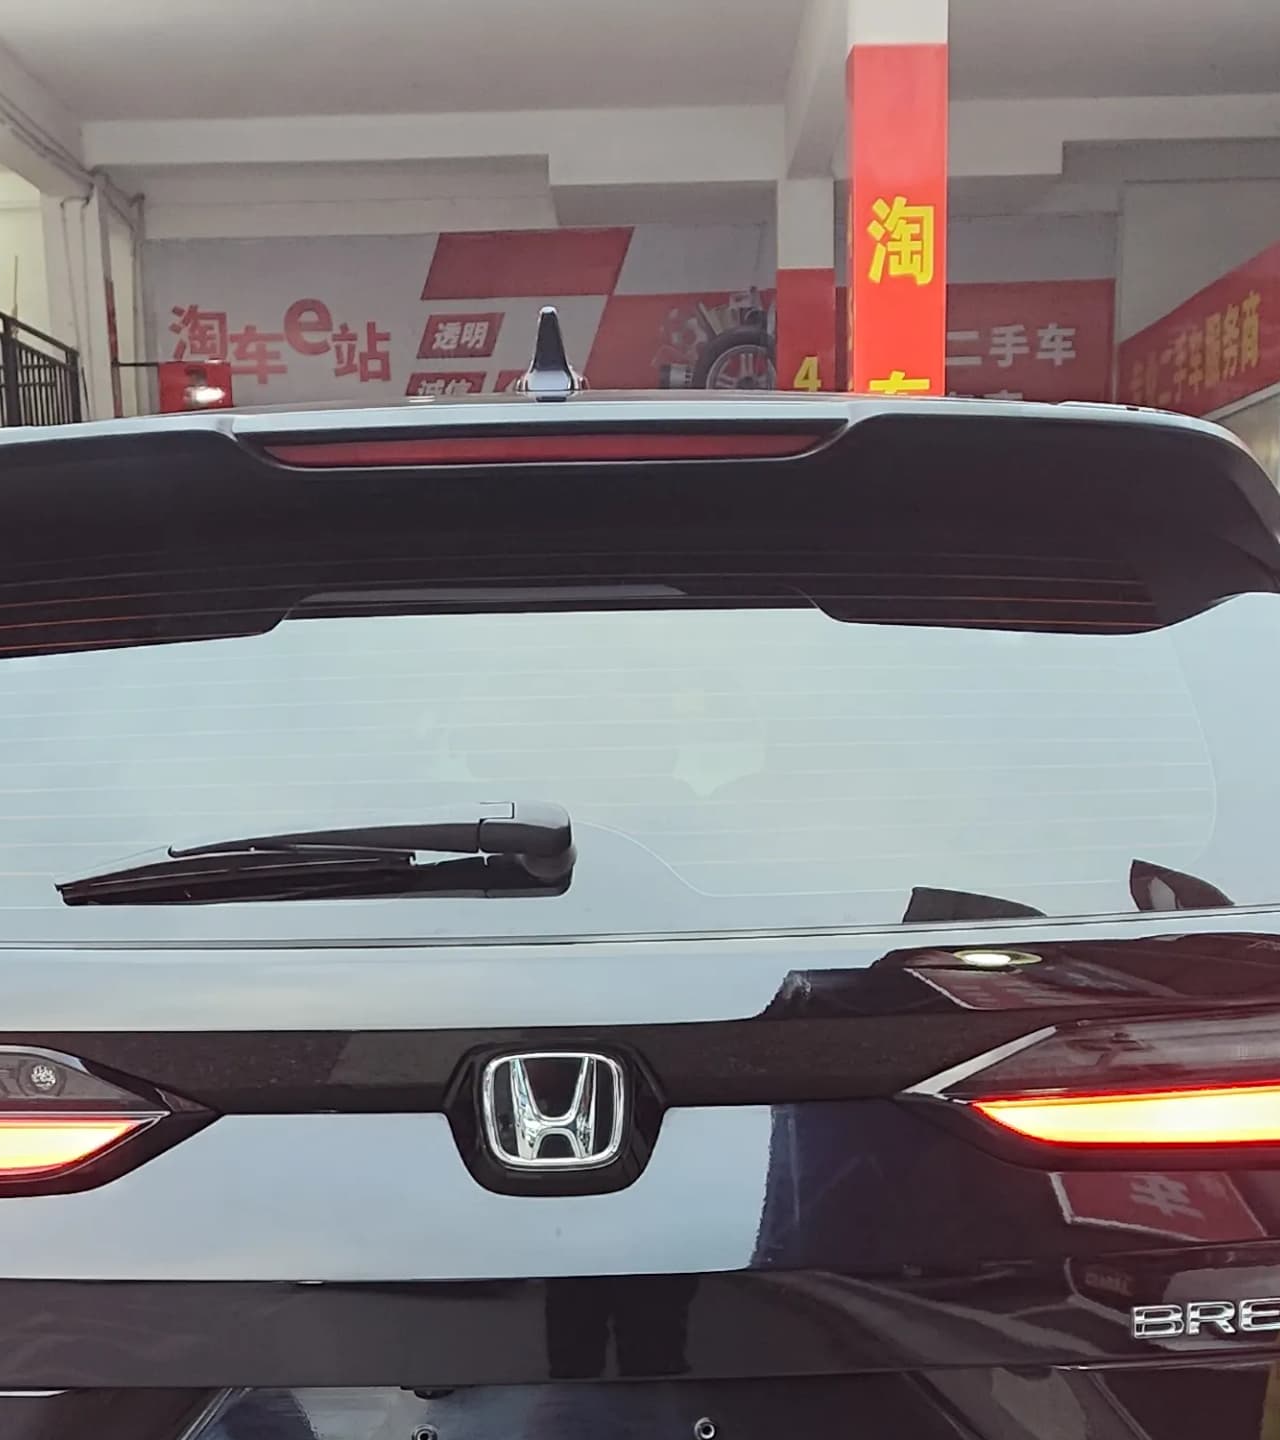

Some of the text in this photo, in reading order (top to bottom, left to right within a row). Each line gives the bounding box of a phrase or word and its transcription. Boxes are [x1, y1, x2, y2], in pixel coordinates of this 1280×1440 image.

[169, 298, 392, 385] 淘车e站
[432, 321, 490, 350] 透明
